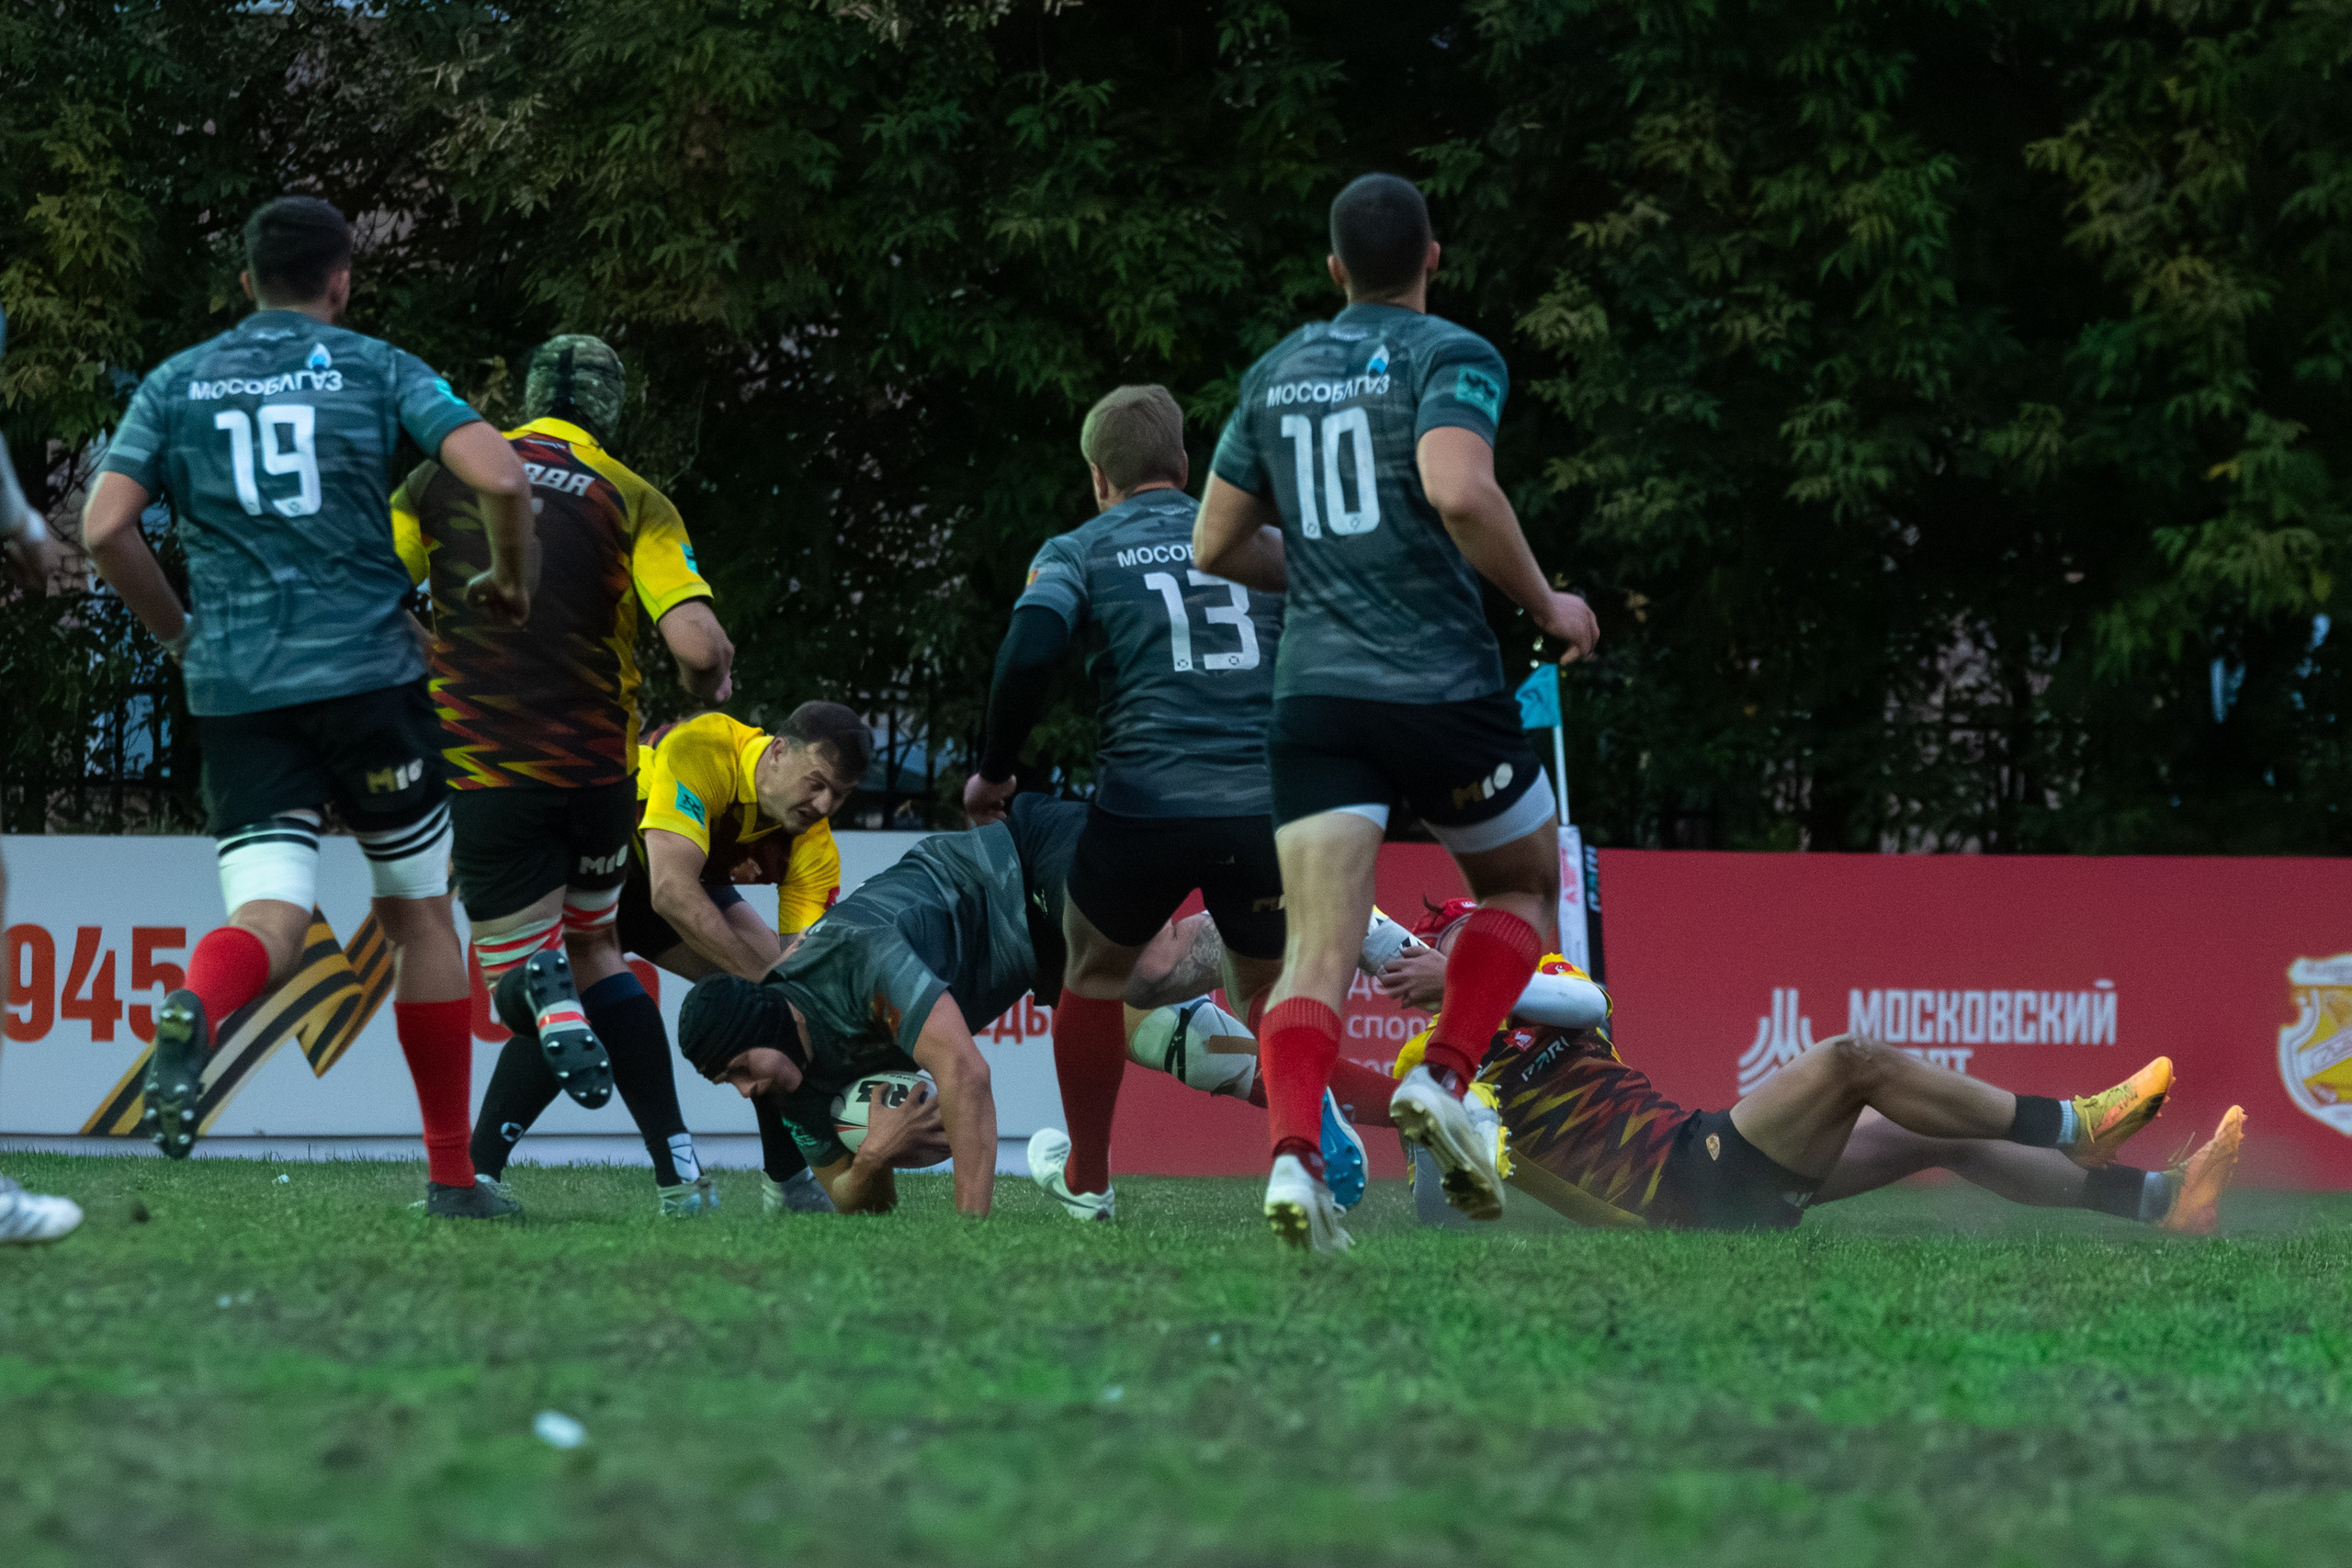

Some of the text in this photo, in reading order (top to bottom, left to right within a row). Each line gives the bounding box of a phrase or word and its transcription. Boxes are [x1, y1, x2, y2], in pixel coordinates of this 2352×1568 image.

[213, 404, 322, 517] 19
[1281, 406, 1380, 540] 10
[1143, 569, 1261, 672] 13
[1346, 1014, 1430, 1042] спор
[1848, 978, 2118, 1045] МОСКОВСКИЙ
